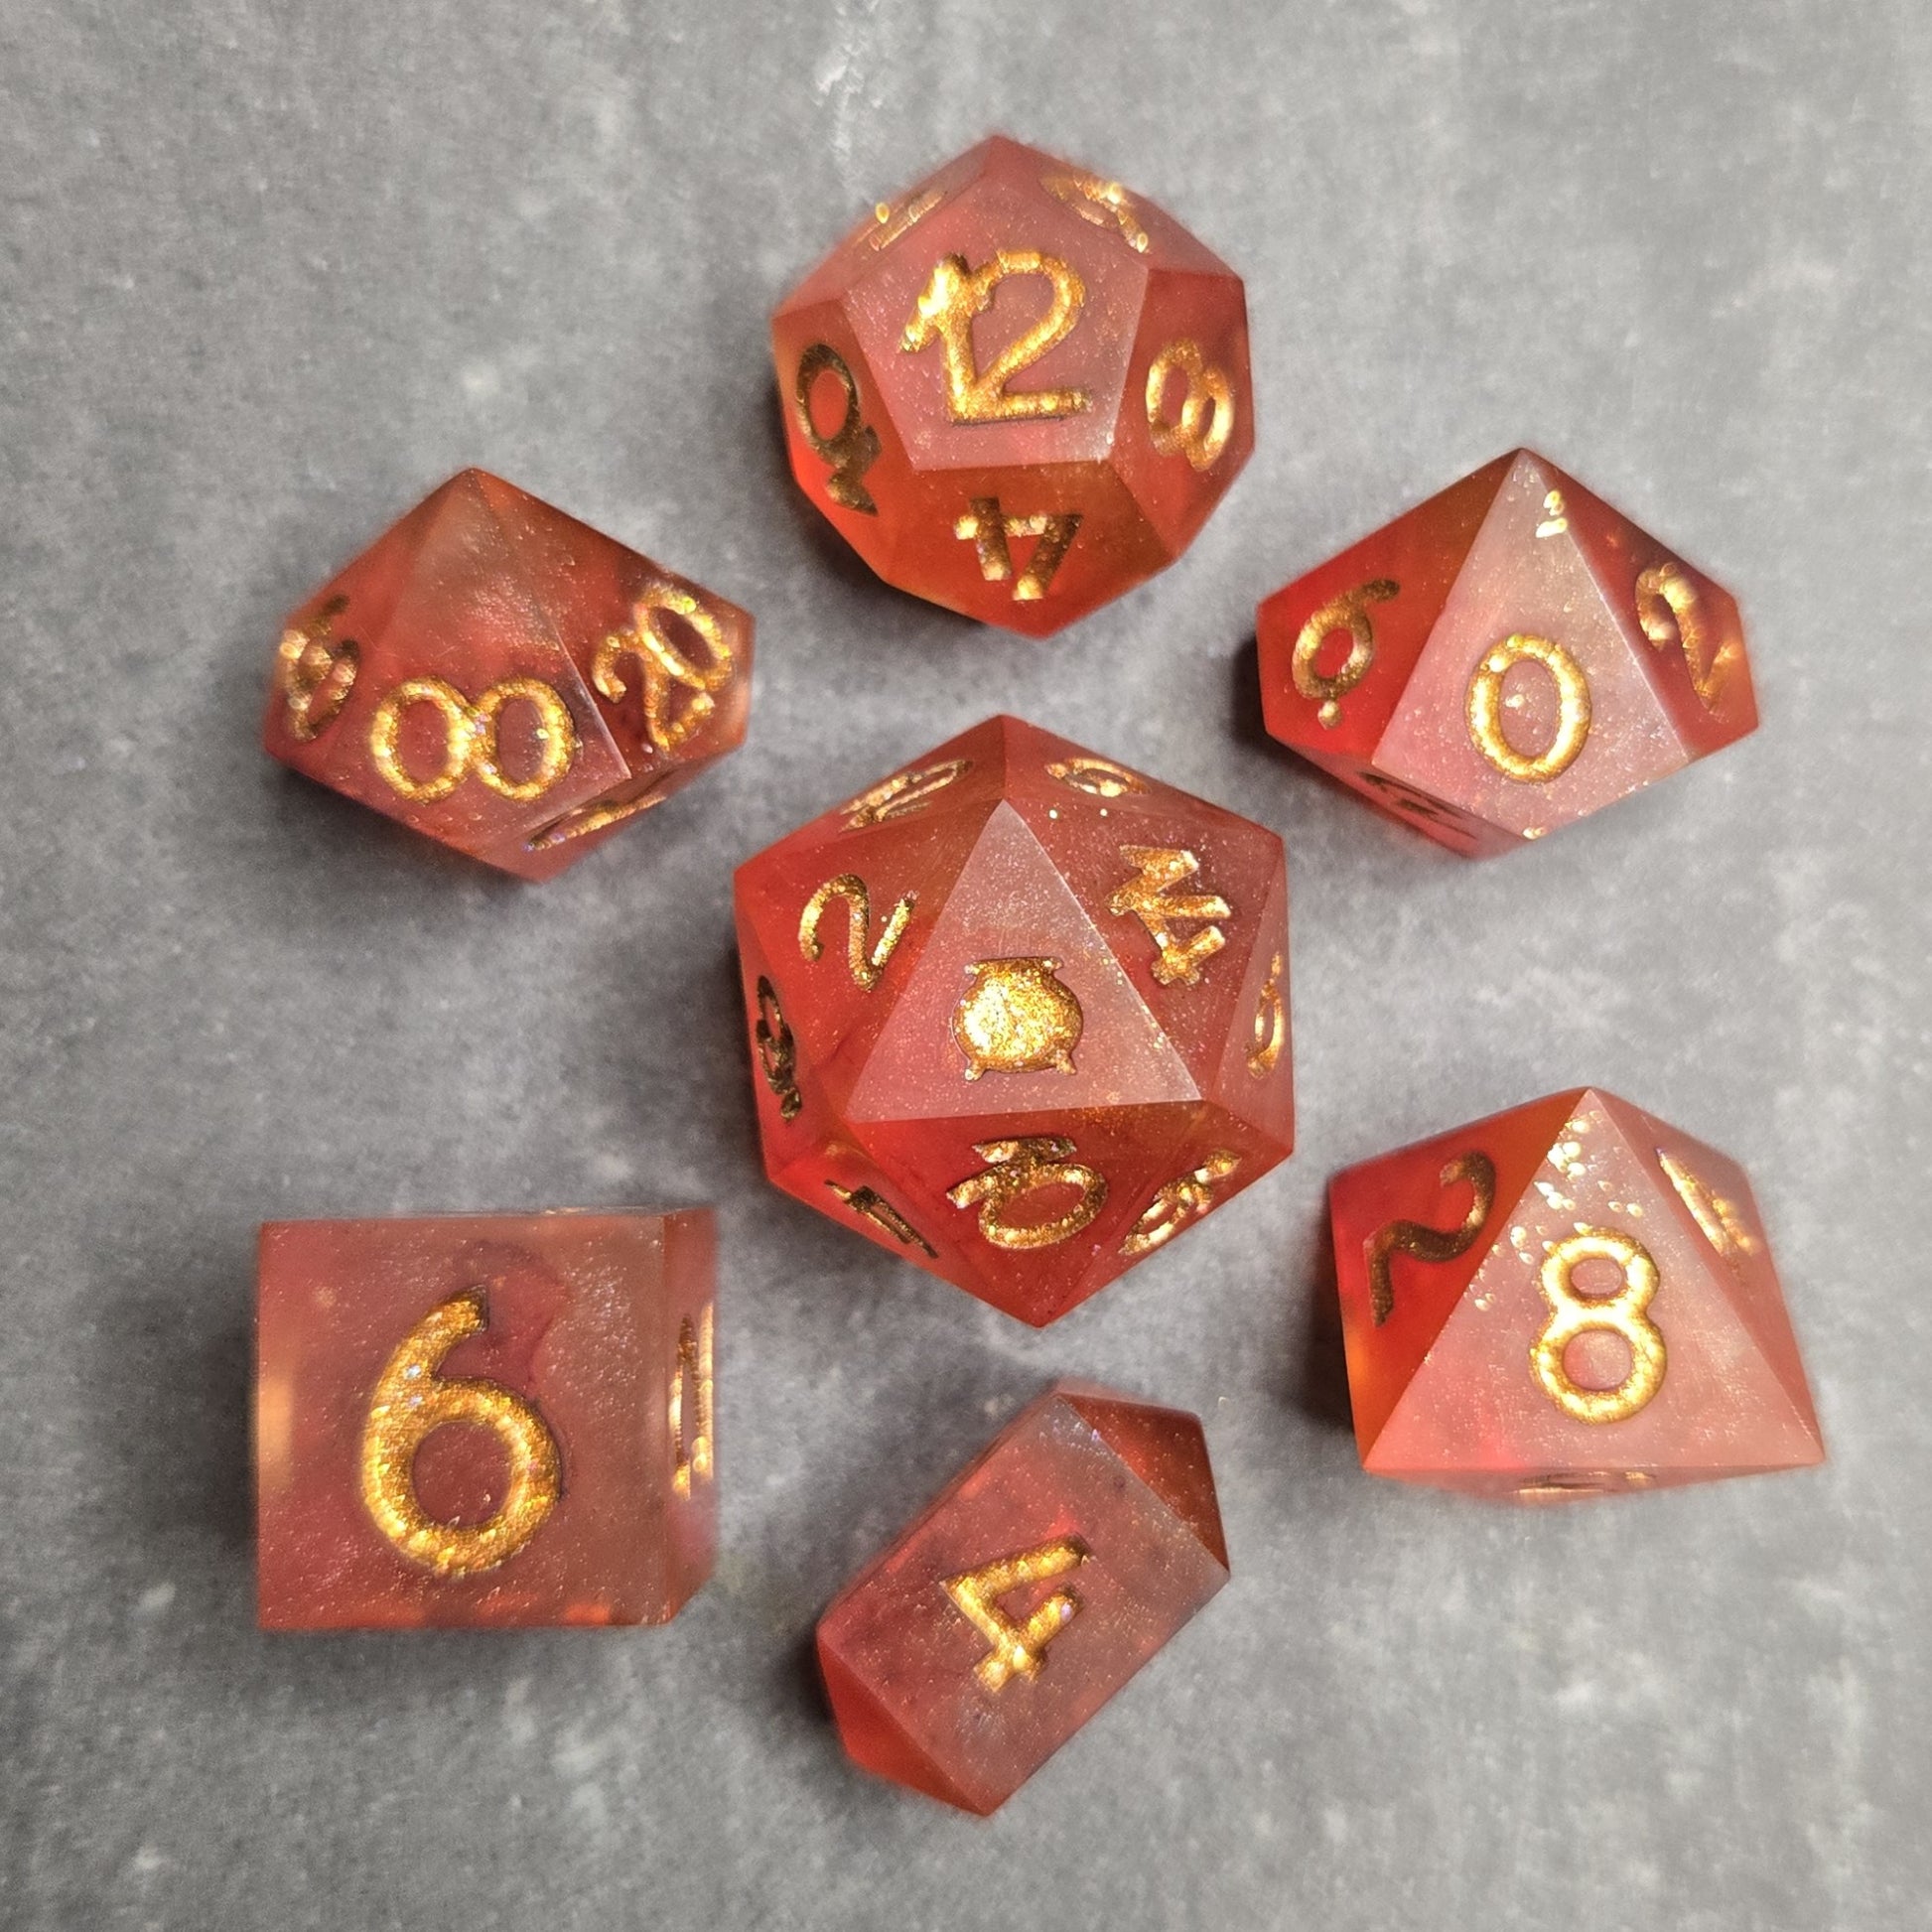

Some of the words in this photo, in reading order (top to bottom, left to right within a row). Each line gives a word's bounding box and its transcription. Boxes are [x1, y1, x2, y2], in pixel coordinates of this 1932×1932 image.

[898, 250, 1090, 425] 12
[1146, 338, 1235, 471] 8
[955, 496, 1085, 601] 4
[592, 583, 734, 752] 20
[1466, 633, 1592, 784] 0
[1635, 561, 1740, 717] 2
[369, 675, 576, 805] 00
[798, 873, 916, 990] 2
[1108, 844, 1231, 986] 14
[1363, 1150, 1497, 1328] 2
[1530, 1226, 1668, 1426] 8
[361, 1284, 563, 1581] 6
[939, 1532, 1092, 1693] 4
